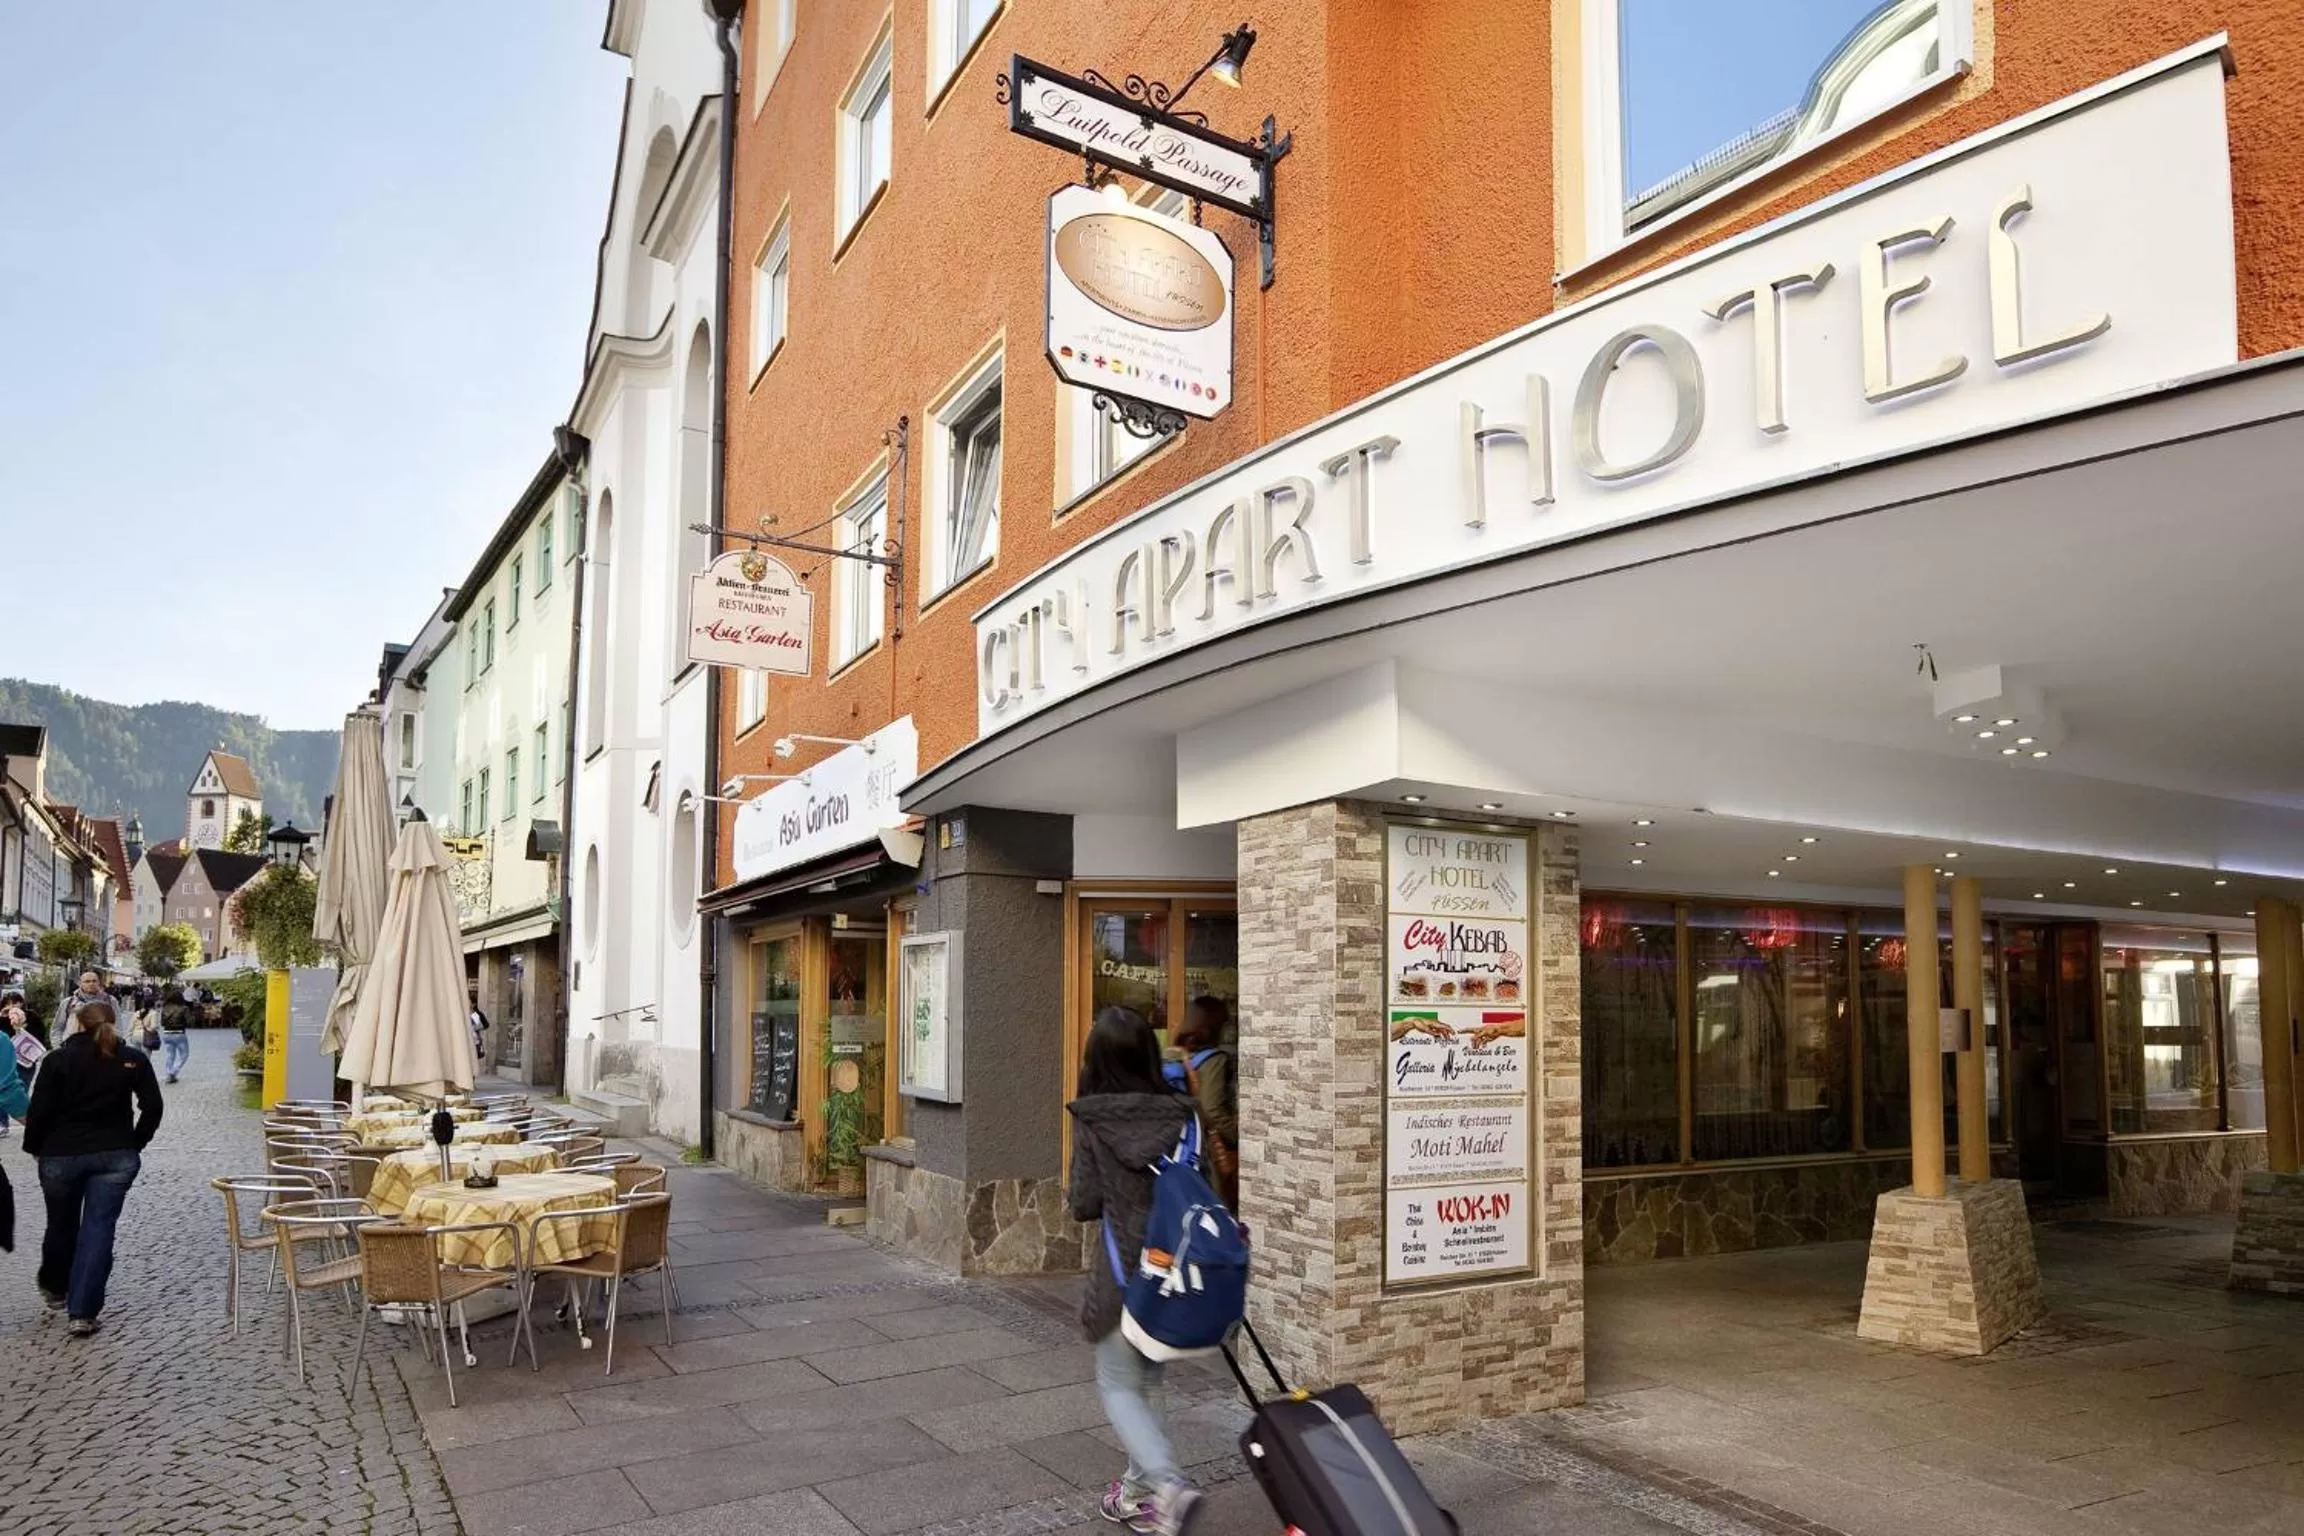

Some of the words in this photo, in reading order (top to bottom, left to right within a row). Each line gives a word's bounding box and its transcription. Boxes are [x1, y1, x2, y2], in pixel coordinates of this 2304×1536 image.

[1034, 88, 1147, 153] Luitpold
[1150, 133, 1248, 194] Passage
[983, 576, 1090, 710] CITY
[1107, 434, 1402, 656] APART
[1459, 182, 2112, 529] HOTEL
[718, 598, 787, 617] RESTAURANT
[695, 619, 743, 645] Asia
[745, 625, 803, 649] Garten
[780, 810, 801, 847] Asia
[806, 793, 849, 835] Garten
[1405, 834, 1446, 859] CITY
[1457, 839, 1512, 863] APART
[1431, 866, 1489, 890] HOTEL
[1403, 919, 1447, 953] City
[1405, 1113, 1453, 1130] Indisches
[1457, 1113, 1512, 1130] Restaurant
[1410, 1136, 1452, 1159] Moti
[1437, 1193, 1510, 1224] WOK-IN
